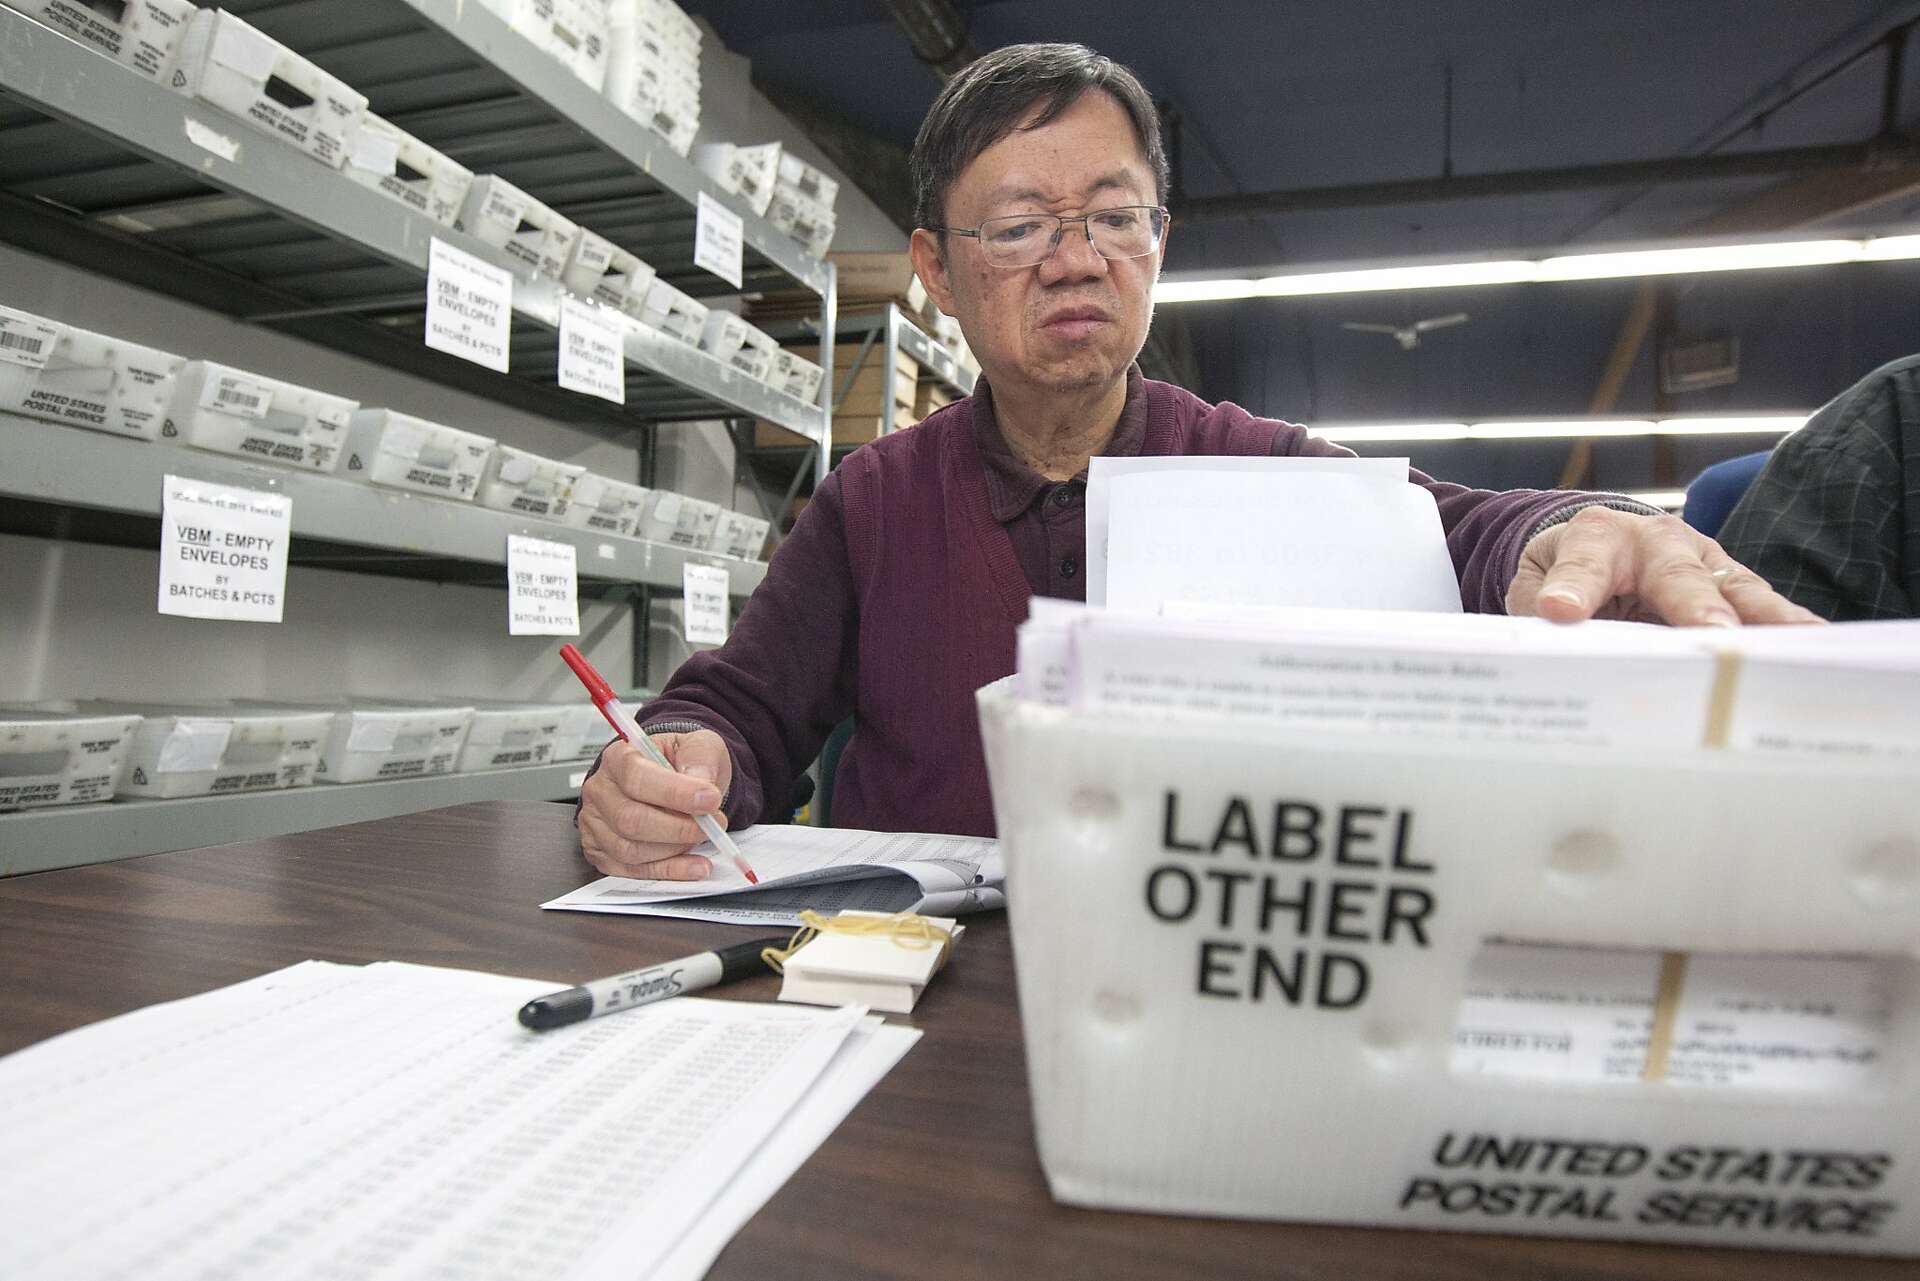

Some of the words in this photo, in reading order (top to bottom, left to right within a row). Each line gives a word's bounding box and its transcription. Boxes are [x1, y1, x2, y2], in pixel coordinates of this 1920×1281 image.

[22, 399, 62, 415] POSTAL
[63, 408, 106, 425] SERVICE
[30, 389, 70, 405] UNITED
[69, 399, 106, 414] STATES
[177, 525, 211, 544] VBM
[224, 533, 274, 551] EMPTY
[180, 546, 269, 571] ENVELOPES
[215, 575, 230, 585] BY
[169, 584, 228, 601] BATCHES
[231, 591, 240, 602] &
[243, 592, 276, 606] PCTS
[1163, 790, 1437, 874] LABEL
[1145, 864, 1437, 948] OTHER
[1197, 940, 1371, 1011] END
[1434, 1131, 1650, 1179] UNITED
[1656, 1144, 1894, 1191] STATES
[1399, 1176, 1623, 1223] POSTAL
[1635, 1191, 1896, 1238] SERVICE
